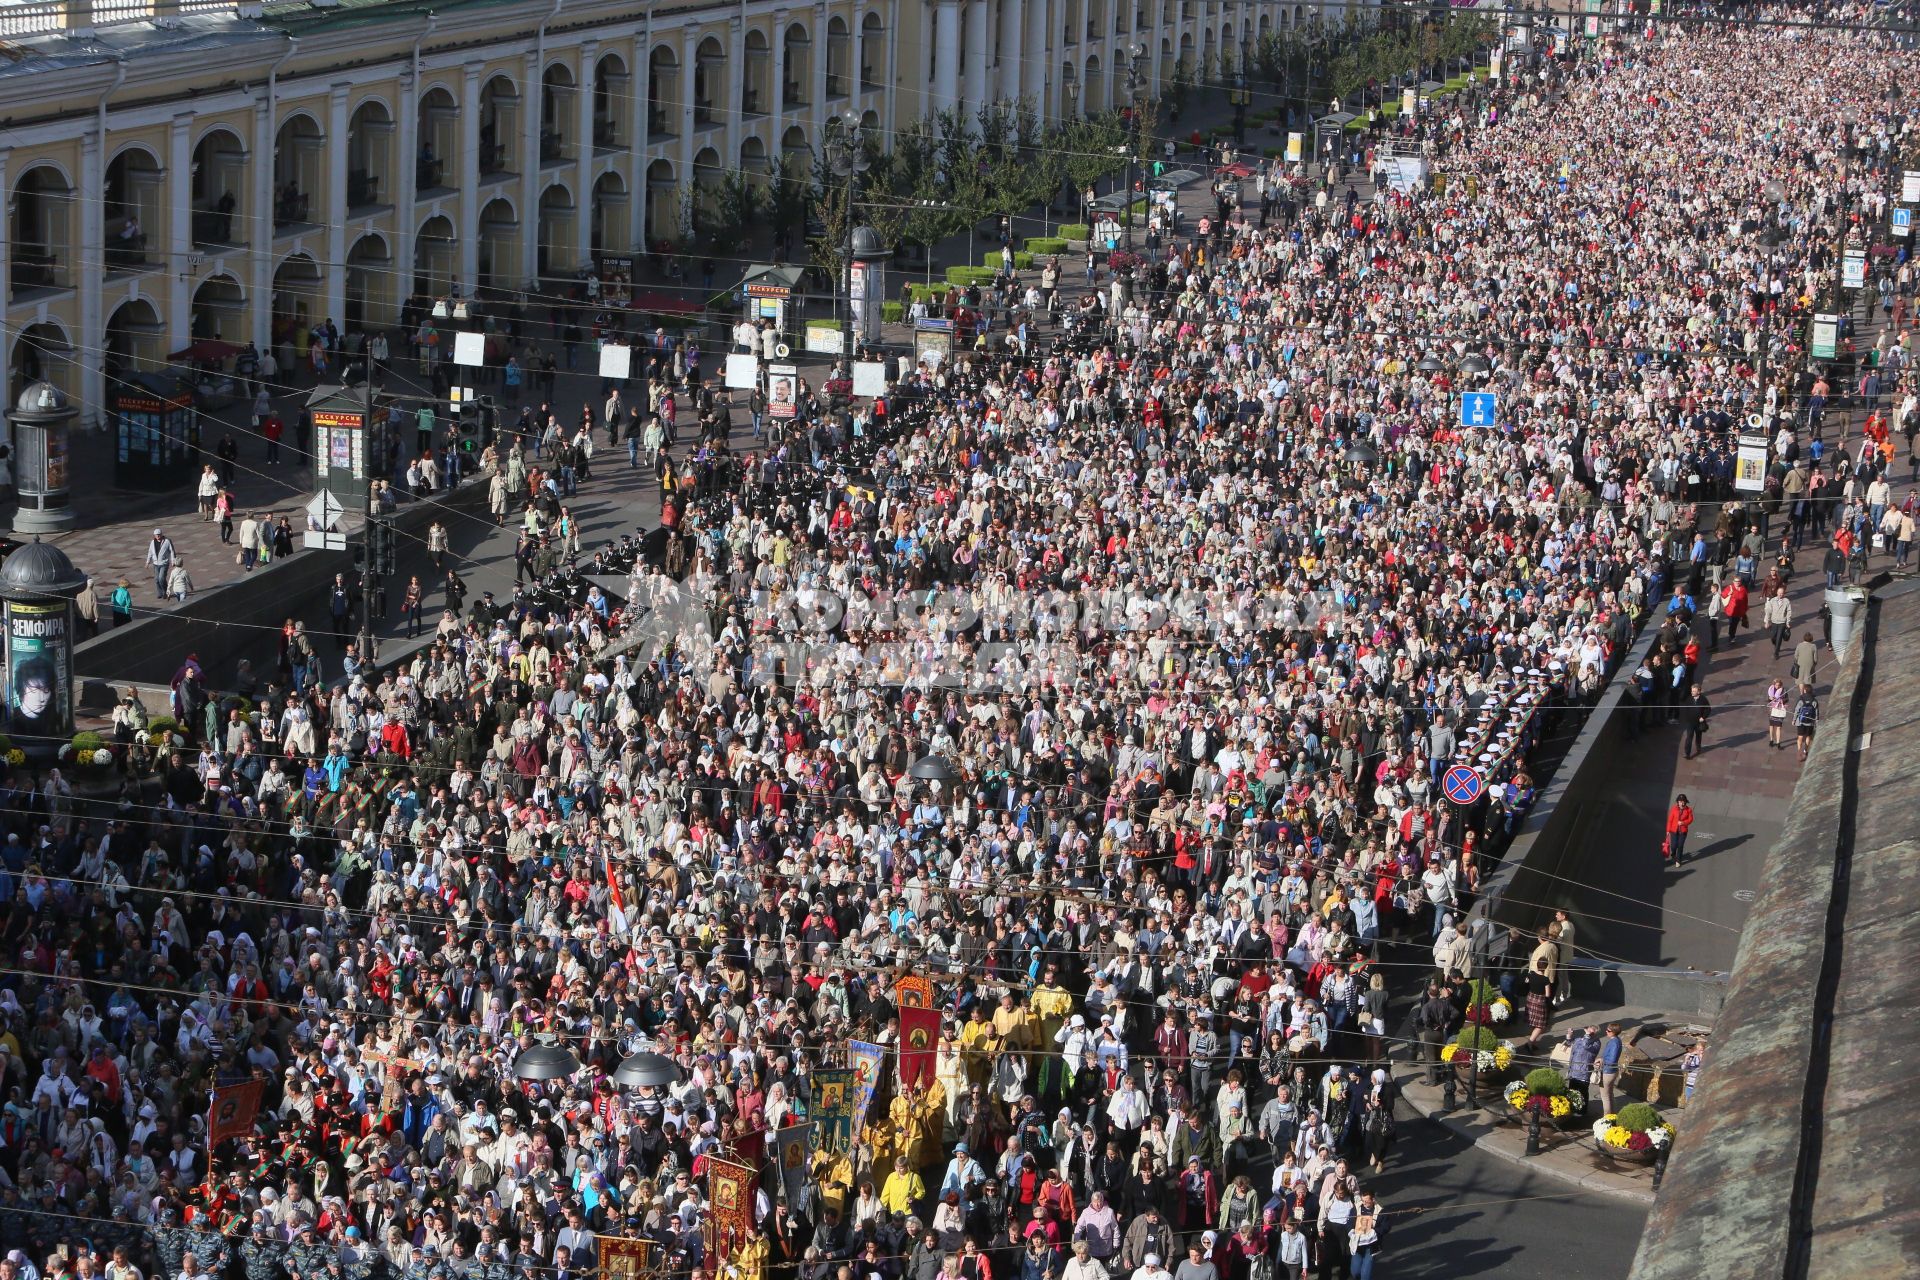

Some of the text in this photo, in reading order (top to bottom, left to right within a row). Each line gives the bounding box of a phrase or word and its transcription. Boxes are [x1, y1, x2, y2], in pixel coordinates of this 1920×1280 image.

[748, 285, 789, 294] ЭКСКУРСИИ
[314, 413, 361, 421] ЭКСКУРСИИ
[12, 617, 65, 638] ЗЕМФИРА
